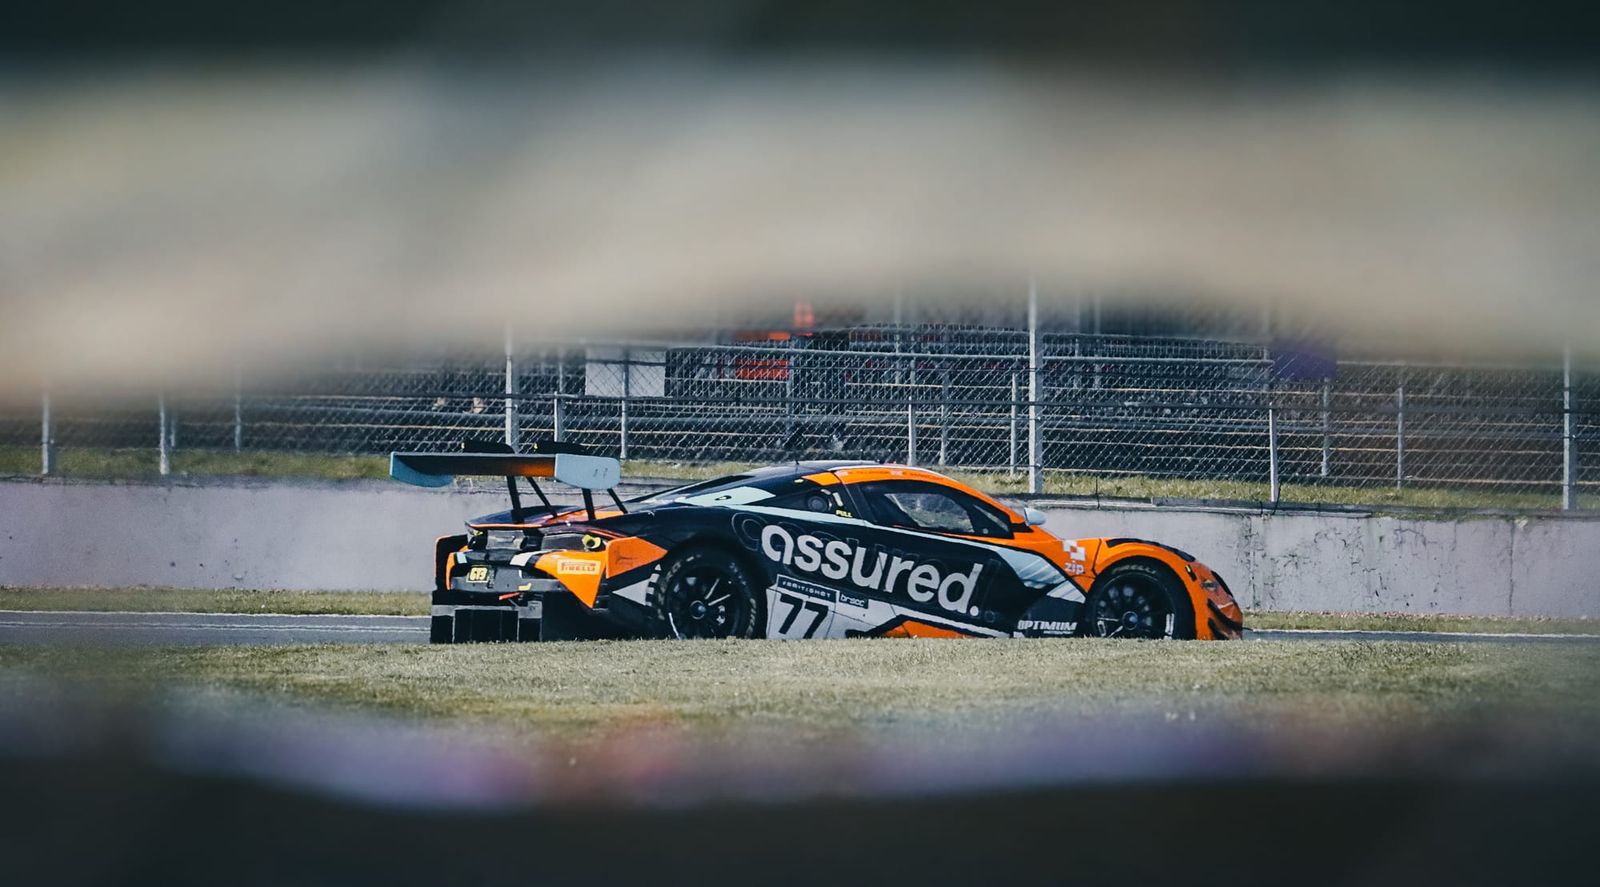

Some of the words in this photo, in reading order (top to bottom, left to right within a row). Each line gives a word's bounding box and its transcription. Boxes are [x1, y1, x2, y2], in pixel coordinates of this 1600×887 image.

[761, 525, 983, 617] assured.
[1065, 560, 1084, 575] zip
[779, 593, 829, 639] 77
[1017, 620, 1077, 630] OPTIMUM
